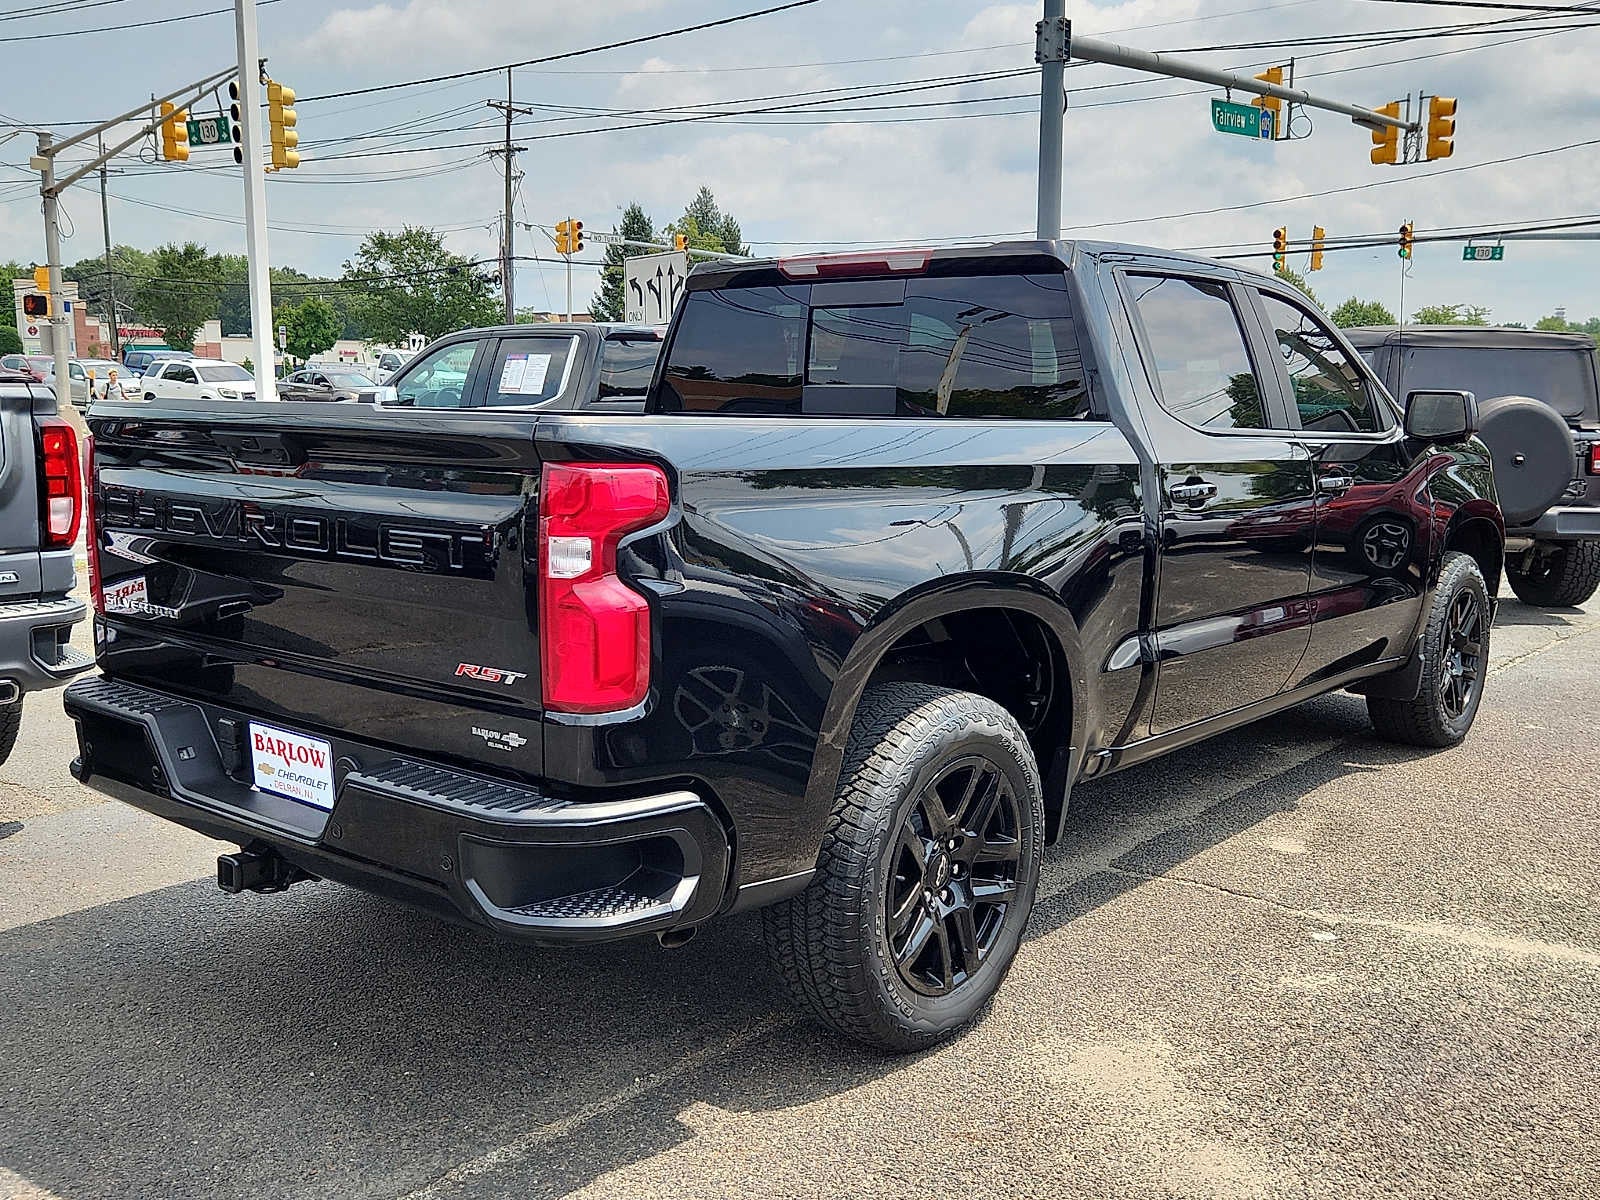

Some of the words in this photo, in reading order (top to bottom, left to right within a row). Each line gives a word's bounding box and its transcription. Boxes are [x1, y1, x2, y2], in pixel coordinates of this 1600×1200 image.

[1215, 107, 1246, 129] Fairview
[201, 125, 216, 139] 130
[593, 233, 601, 241] NO
[604, 235, 622, 244] TURNS
[1477, 249, 1490, 257] 130
[628, 311, 644, 322] ONLY
[101, 485, 485, 570] CHEVROLET
[454, 662, 528, 685] RST
[471, 726, 501, 740] BARLOW
[254, 732, 326, 769] BARLOW
[277, 769, 329, 791] CHEVROLET
